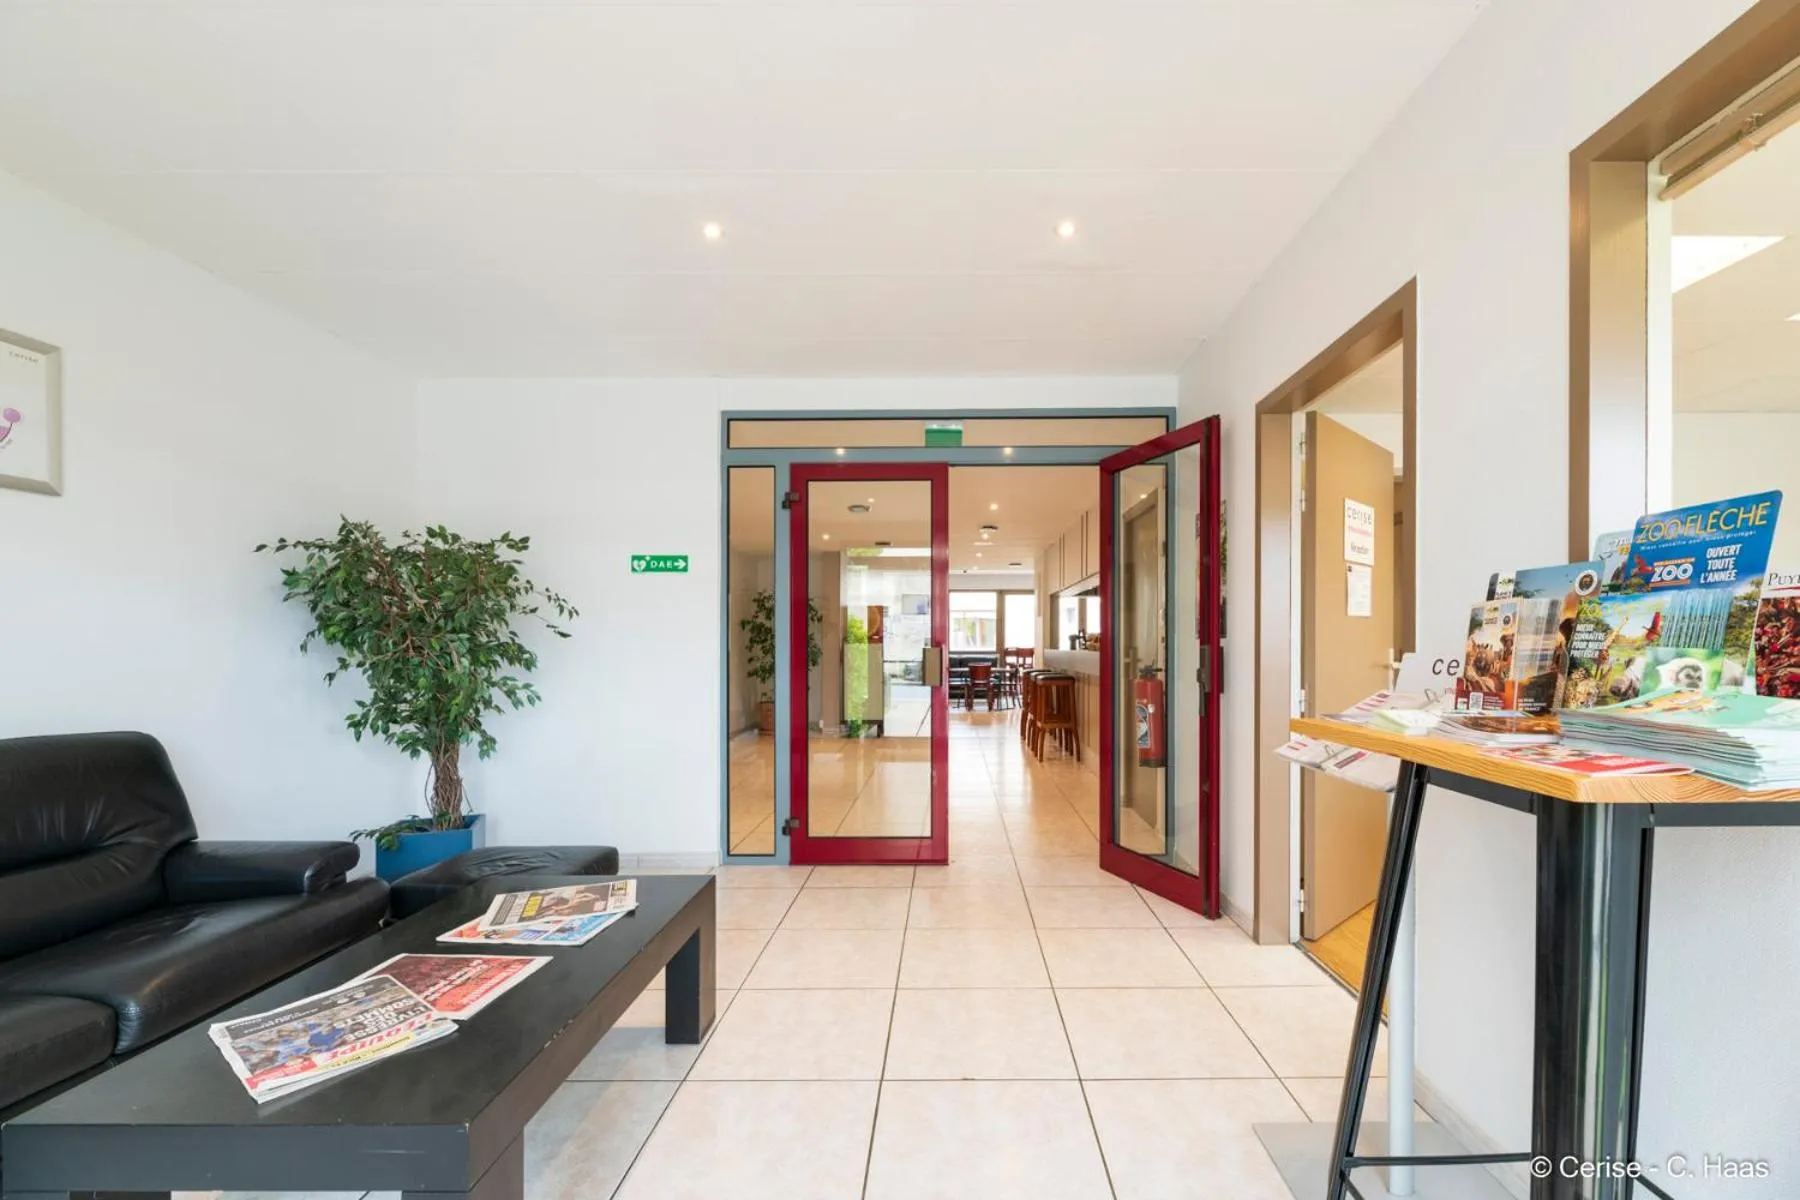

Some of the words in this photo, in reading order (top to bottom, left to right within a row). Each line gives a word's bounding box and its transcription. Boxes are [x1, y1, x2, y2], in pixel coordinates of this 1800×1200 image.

[1706, 543, 1742, 559] OUVERT
[650, 559, 673, 569] DAE
[1707, 557, 1736, 571] TOUTE
[1650, 563, 1694, 582] ZOO
